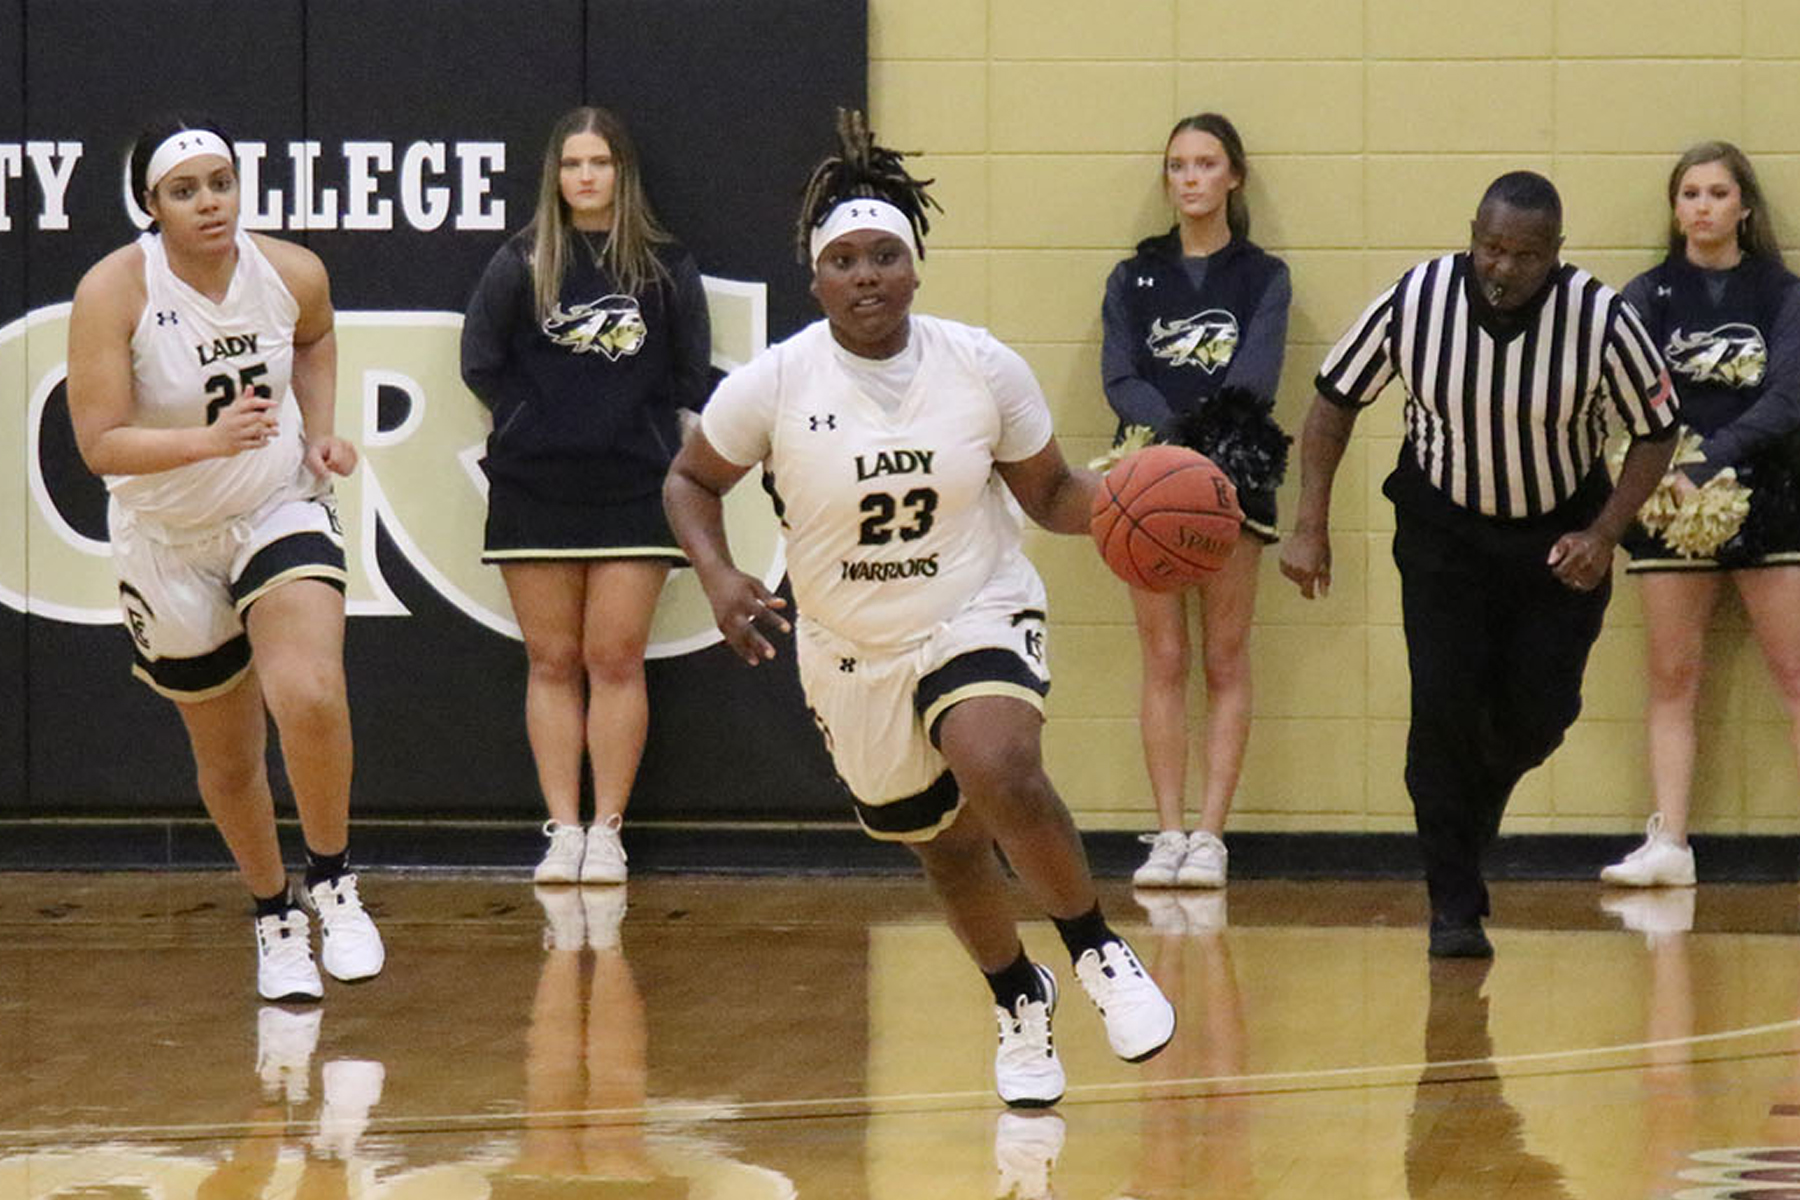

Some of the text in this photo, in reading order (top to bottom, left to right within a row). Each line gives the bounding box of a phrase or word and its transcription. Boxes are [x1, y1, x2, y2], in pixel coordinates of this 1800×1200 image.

[124, 140, 506, 232] LLEGE
[197, 333, 258, 367] LADY
[854, 449, 935, 482] LADY
[857, 487, 939, 546] 23
[841, 552, 939, 582] WARRIORS
